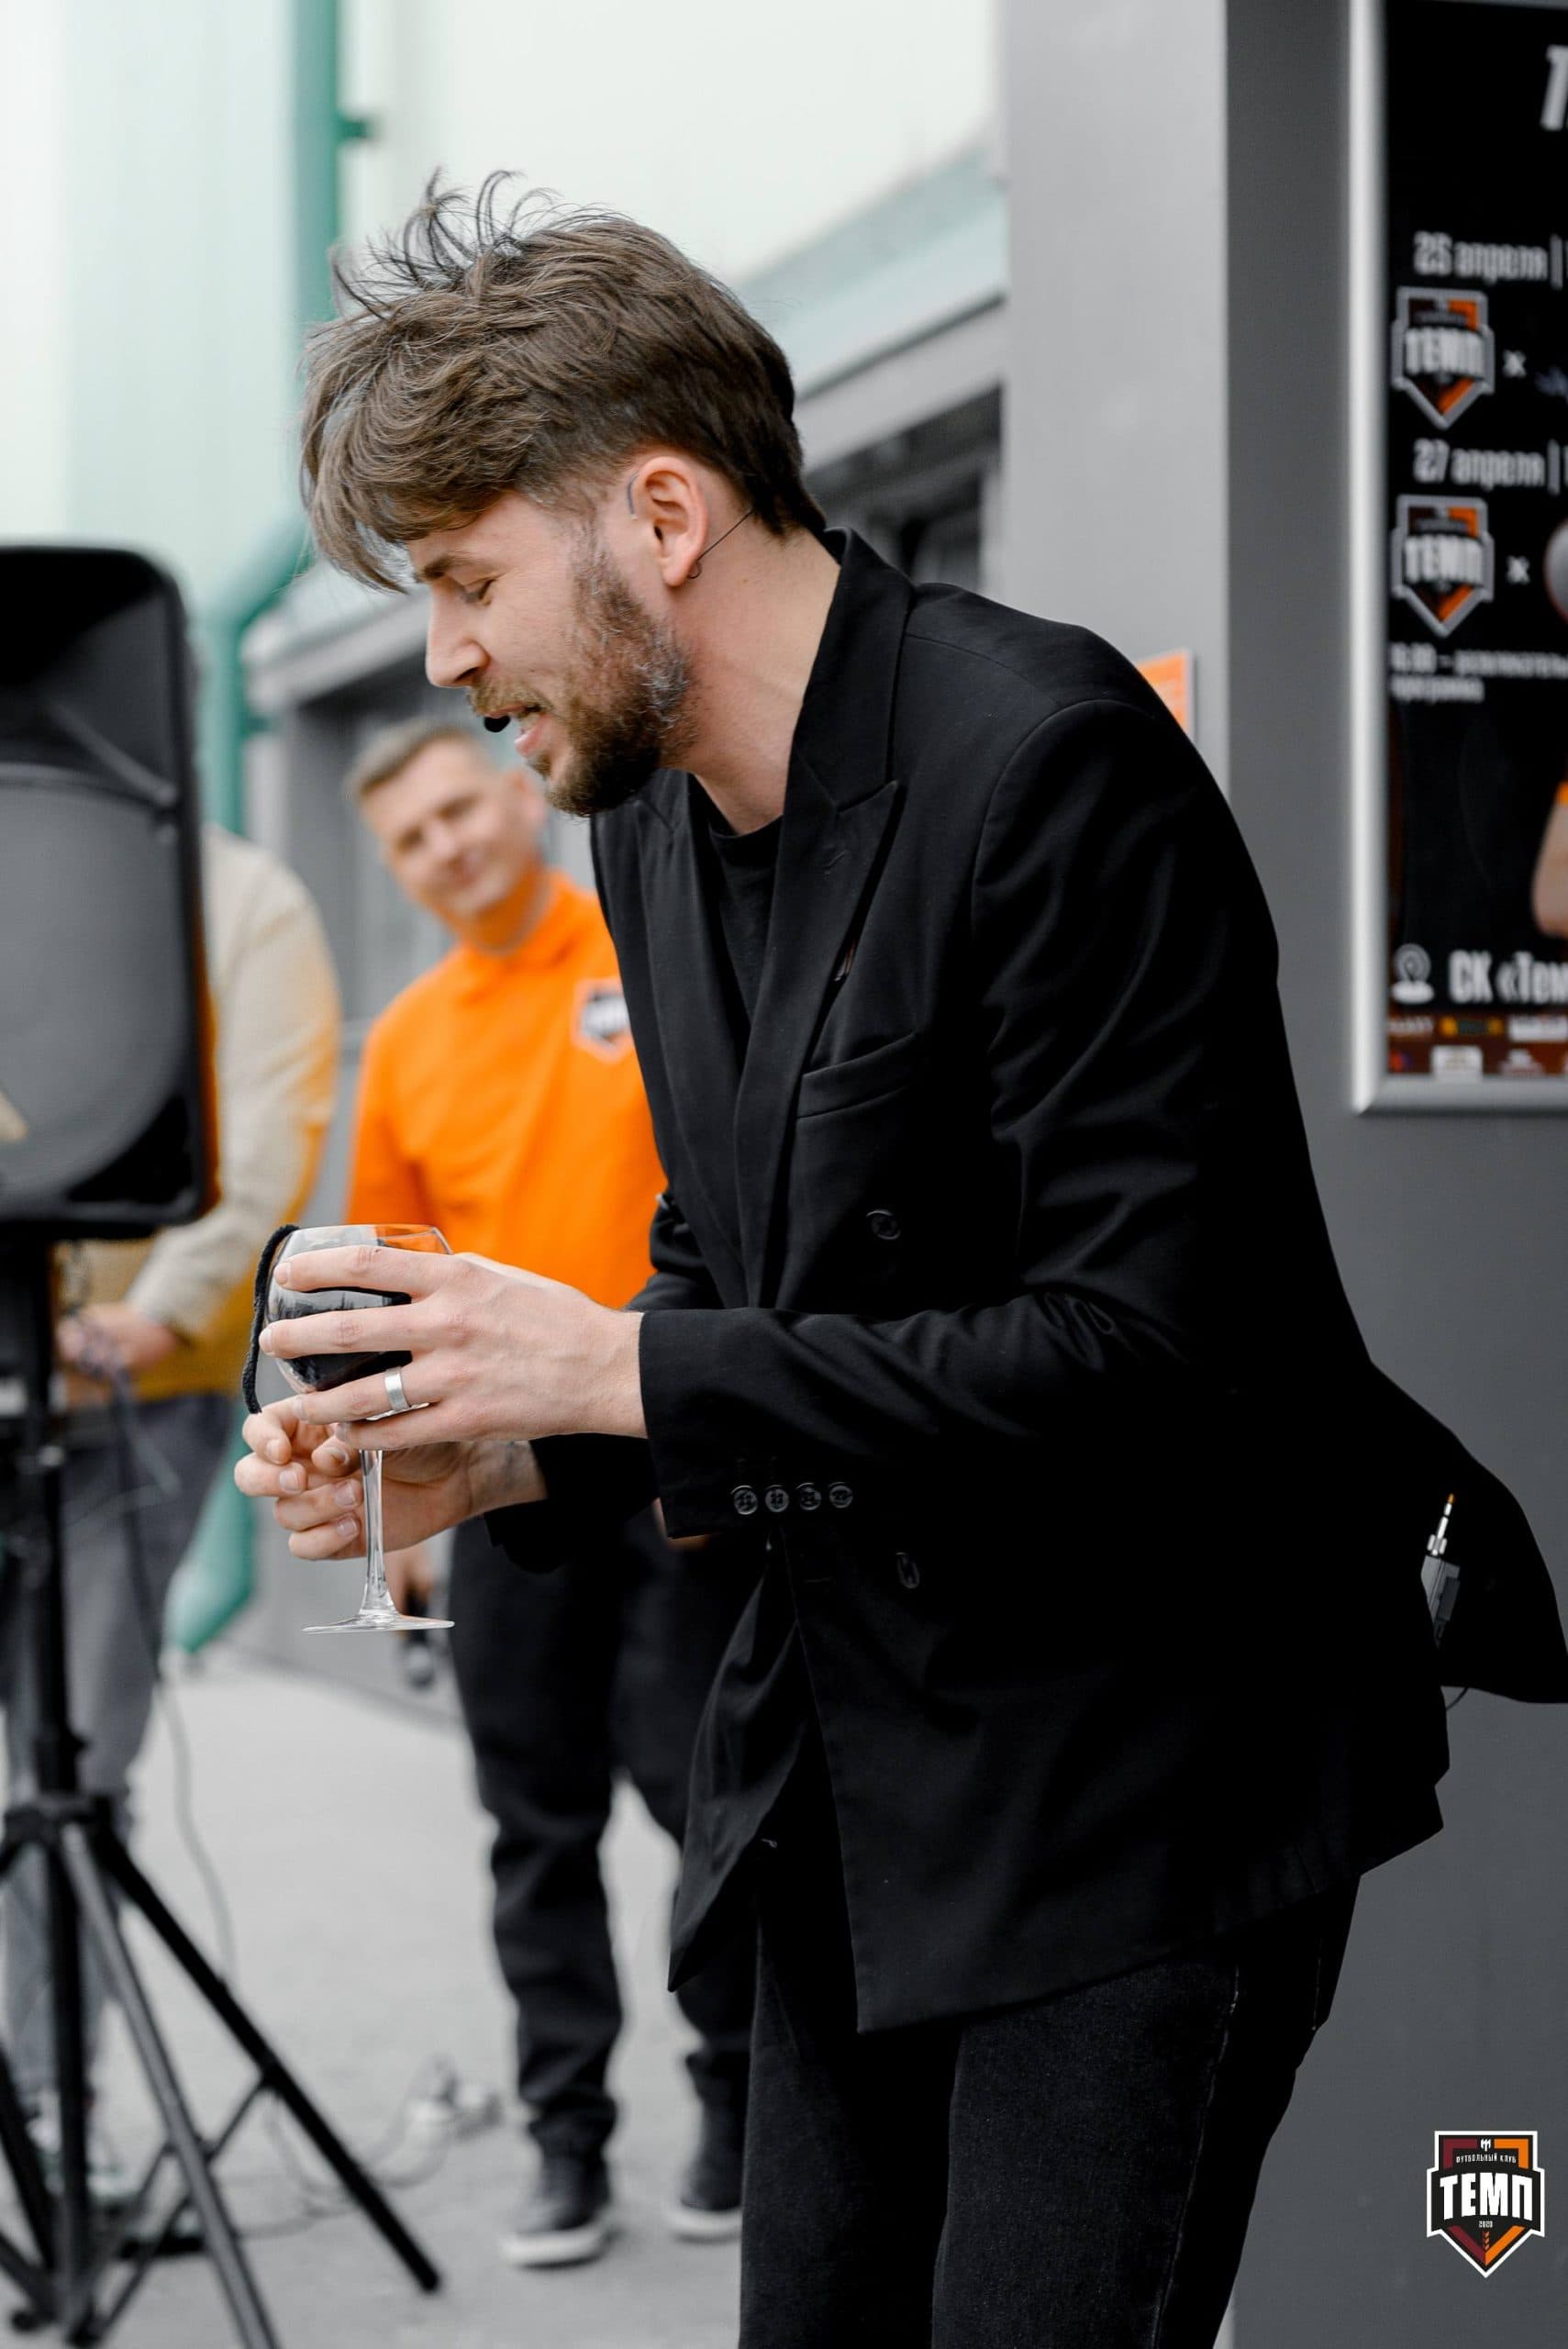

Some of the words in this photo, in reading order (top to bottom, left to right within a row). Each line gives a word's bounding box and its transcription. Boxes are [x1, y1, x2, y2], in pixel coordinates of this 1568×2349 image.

[1405, 326, 1485, 375] ТЕМП
[1405, 534, 1484, 584] ТЕМП
[1449, 950, 1493, 1003] СК
